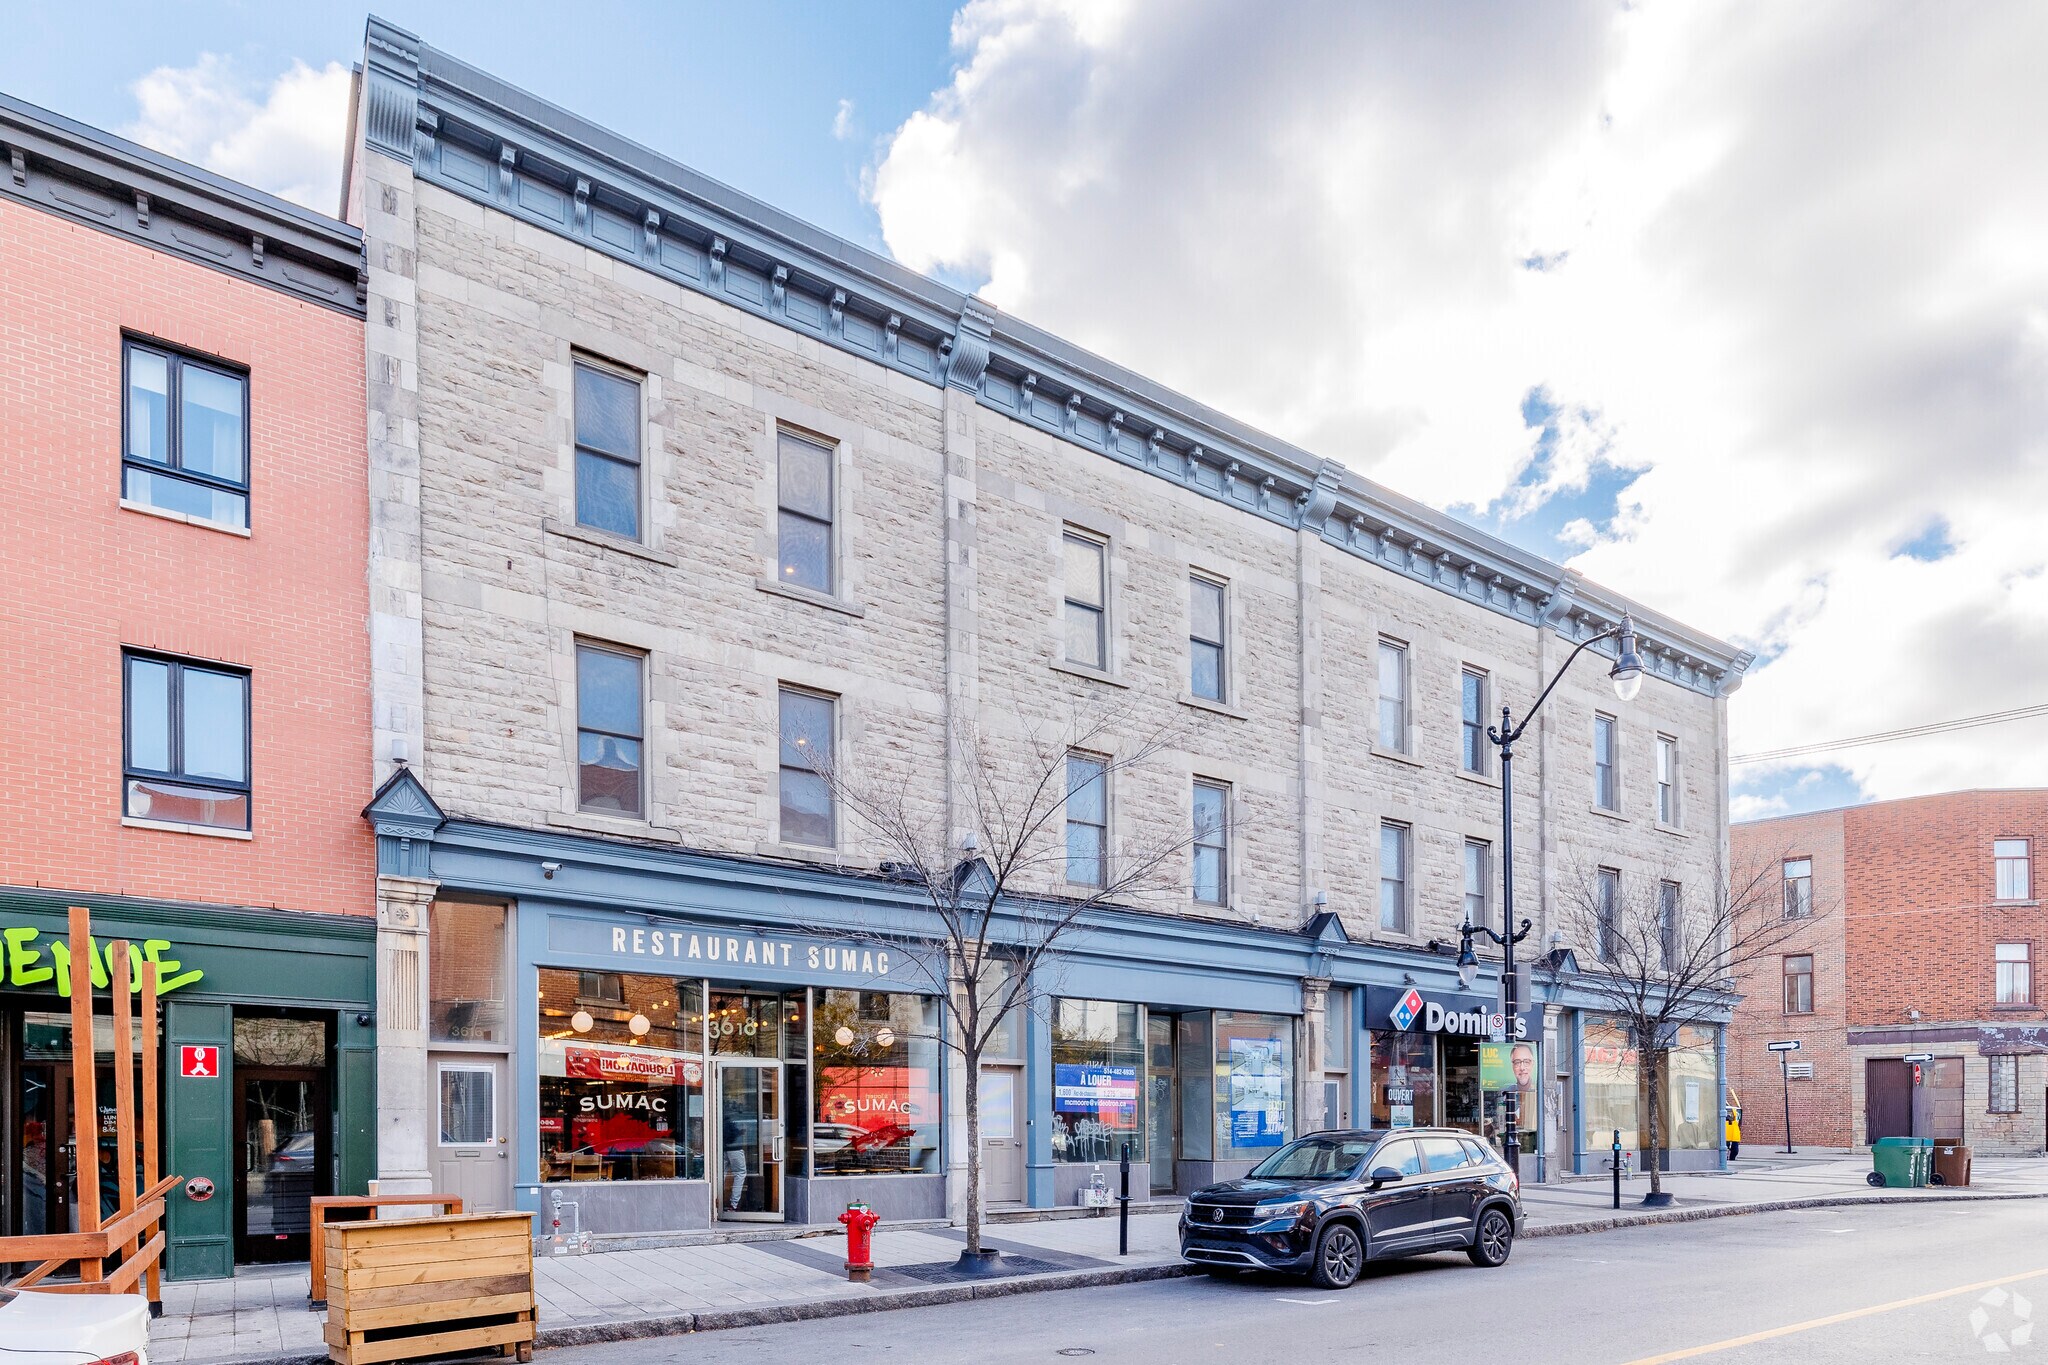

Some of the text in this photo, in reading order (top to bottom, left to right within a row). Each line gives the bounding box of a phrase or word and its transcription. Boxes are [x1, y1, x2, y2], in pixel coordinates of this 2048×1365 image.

[612, 927, 889, 974] RESTAURANT SUMAC
[709, 1015, 757, 1039] 3618
[1425, 1001, 1527, 1039] Domi's
[1081, 1071, 1112, 1087] À LOUER
[579, 1094, 667, 1112] SUMAC
[1388, 1089, 1413, 1101] OUVERT
[844, 1099, 911, 1114] SUMAC
